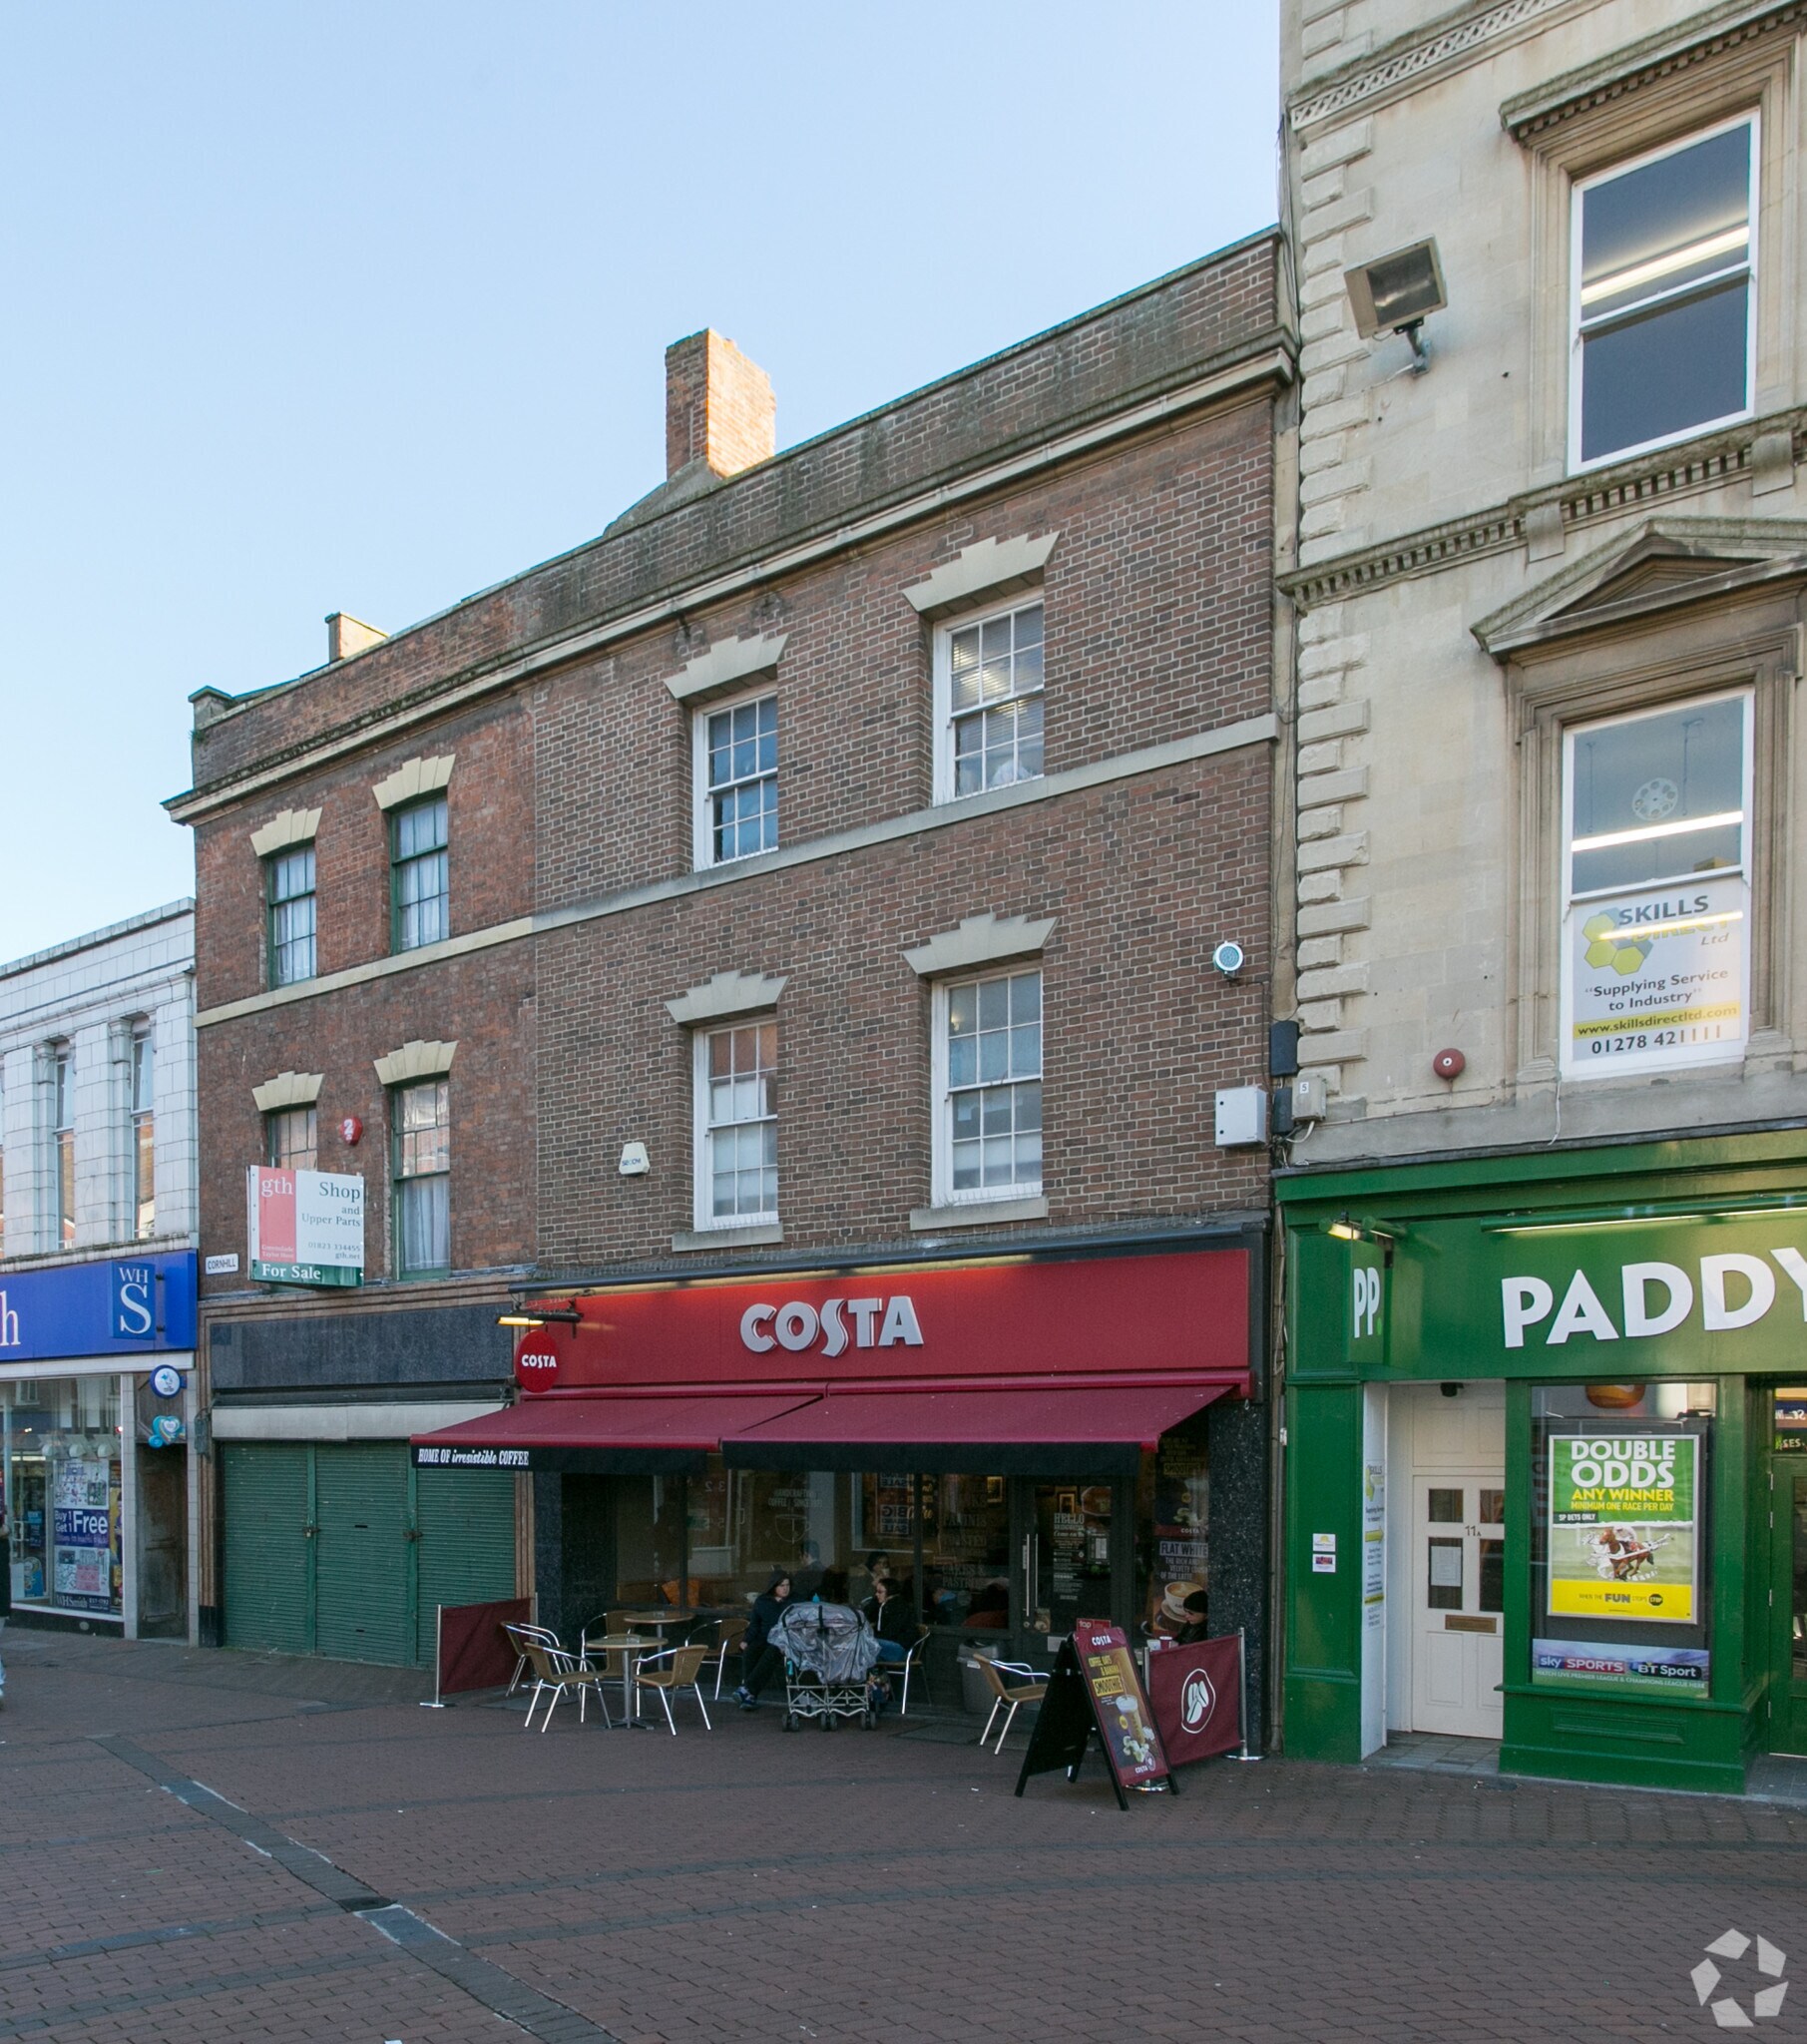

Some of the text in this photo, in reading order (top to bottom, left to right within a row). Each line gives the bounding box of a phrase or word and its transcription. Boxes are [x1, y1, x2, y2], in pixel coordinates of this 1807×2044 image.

[1618, 895, 1709, 926] SKILLS
[1700, 933, 1729, 946] Ltd
[1670, 969, 1728, 986] Service
[1608, 998, 1624, 1011] to
[1579, 1005, 1737, 1035] www.skillsdirectltd.com
[1592, 1025, 1721, 1054] 01278 421111
[261, 1177, 360, 1203] gth Shop
[301, 1214, 360, 1227] Upper Parts
[208, 1259, 236, 1270] CORNHILL
[262, 1264, 321, 1279] For Sale
[119, 1268, 148, 1283] WH
[120, 1283, 152, 1333] S
[740, 1295, 924, 1357] COSTA
[522, 1354, 557, 1368] COSTA
[418, 1449, 529, 1465] HOME OF irresistible COFFEE
[1572, 1440, 1675, 1460] DOUBLE
[1572, 1460, 1674, 1488] ODDS
[1573, 1488, 1674, 1501] ANY WINNER
[1571, 1501, 1604, 1510] MINIMUM
[1622, 1502, 1641, 1511] RACE
[1643, 1502, 1657, 1511] PER
[55, 1510, 66, 1522] Buy
[73, 1510, 108, 1534] Free
[1054, 1513, 1085, 1524] HELLO
[55, 1523, 68, 1533] Get
[1161, 1543, 1207, 1556] FLAT WHITE
[1604, 1593, 1630, 1603] FUN
[1092, 1635, 1112, 1646] COSTA
[1541, 1657, 1696, 1678] sky SPORTS BT Sport
[1626, 1677, 1663, 1686] CHAMPIONS
[1664, 1679, 1688, 1688] LEAGUE
